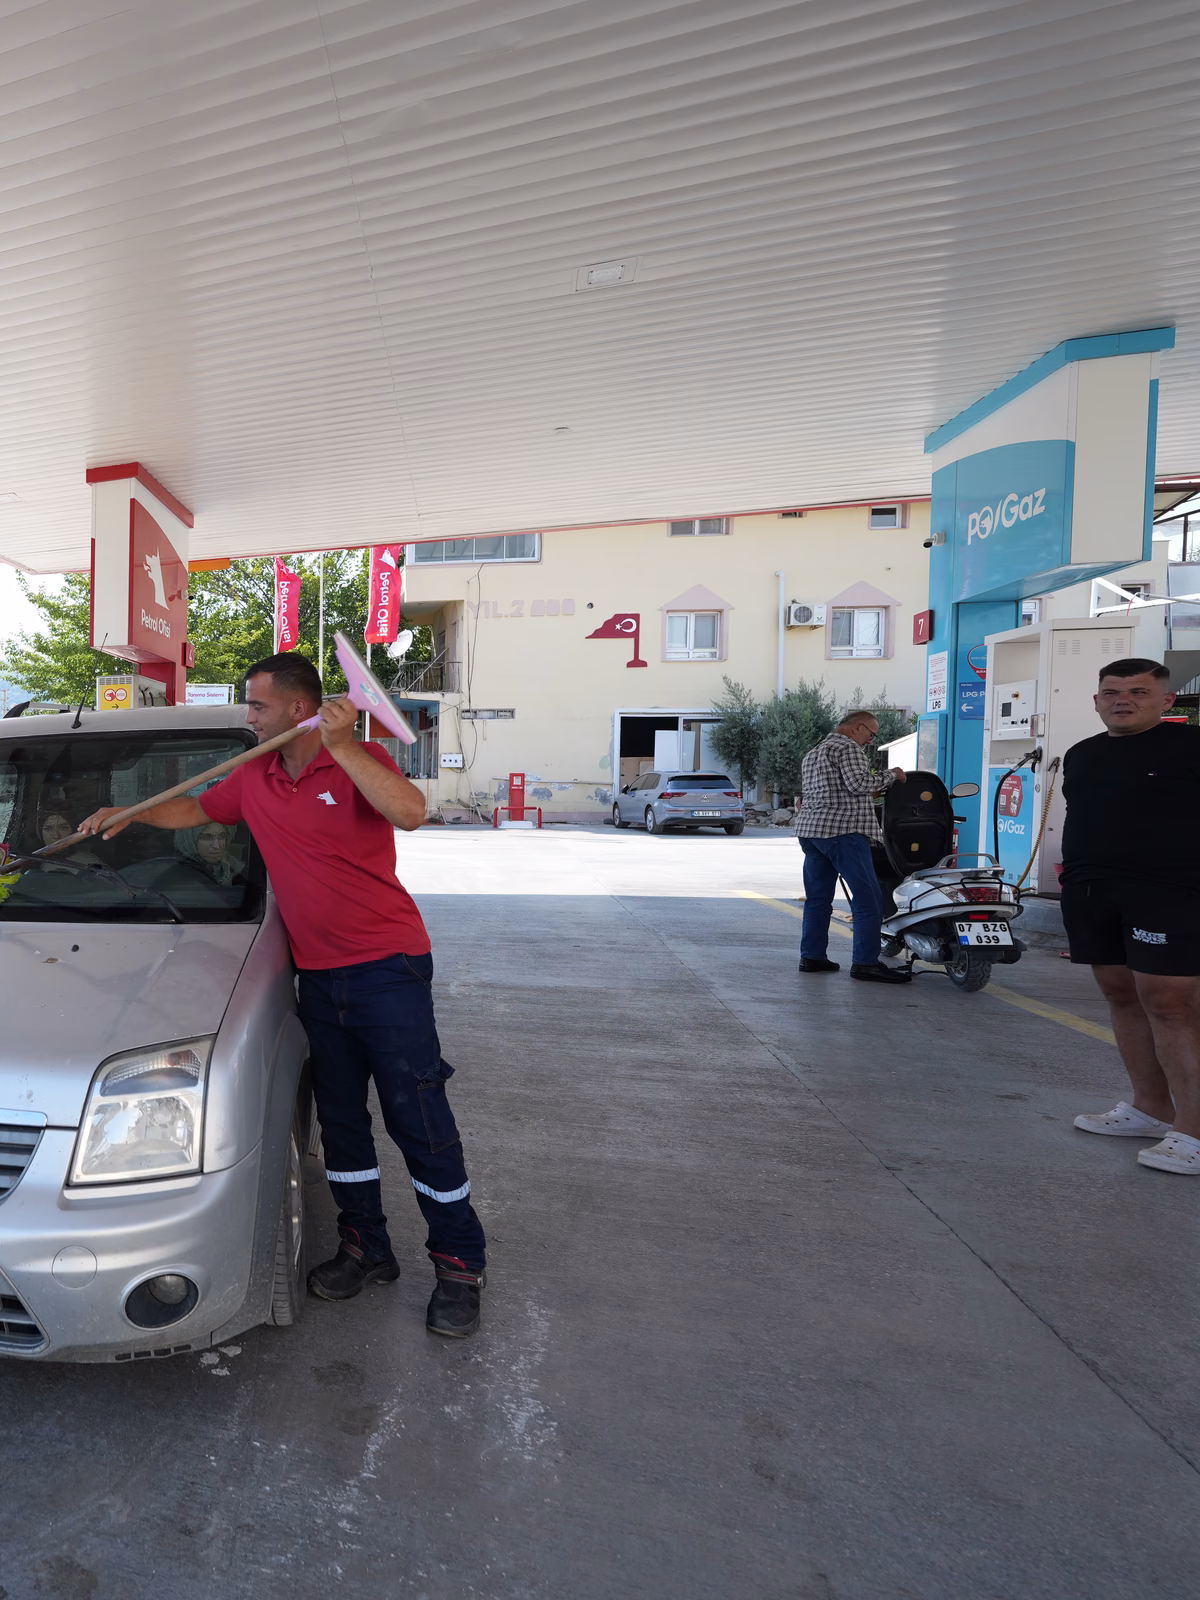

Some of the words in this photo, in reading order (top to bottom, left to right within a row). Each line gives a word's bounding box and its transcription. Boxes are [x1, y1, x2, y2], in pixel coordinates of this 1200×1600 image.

[142, 608, 158, 632] Petrol
[159, 618, 170, 638] Ofisi
[918, 618, 924, 635] 7
[932, 701, 941, 709] LPG
[992, 819, 1025, 834] O/Gaz
[958, 924, 972, 932] 07
[982, 924, 1007, 932] BZG
[976, 935, 1000, 944] 039
